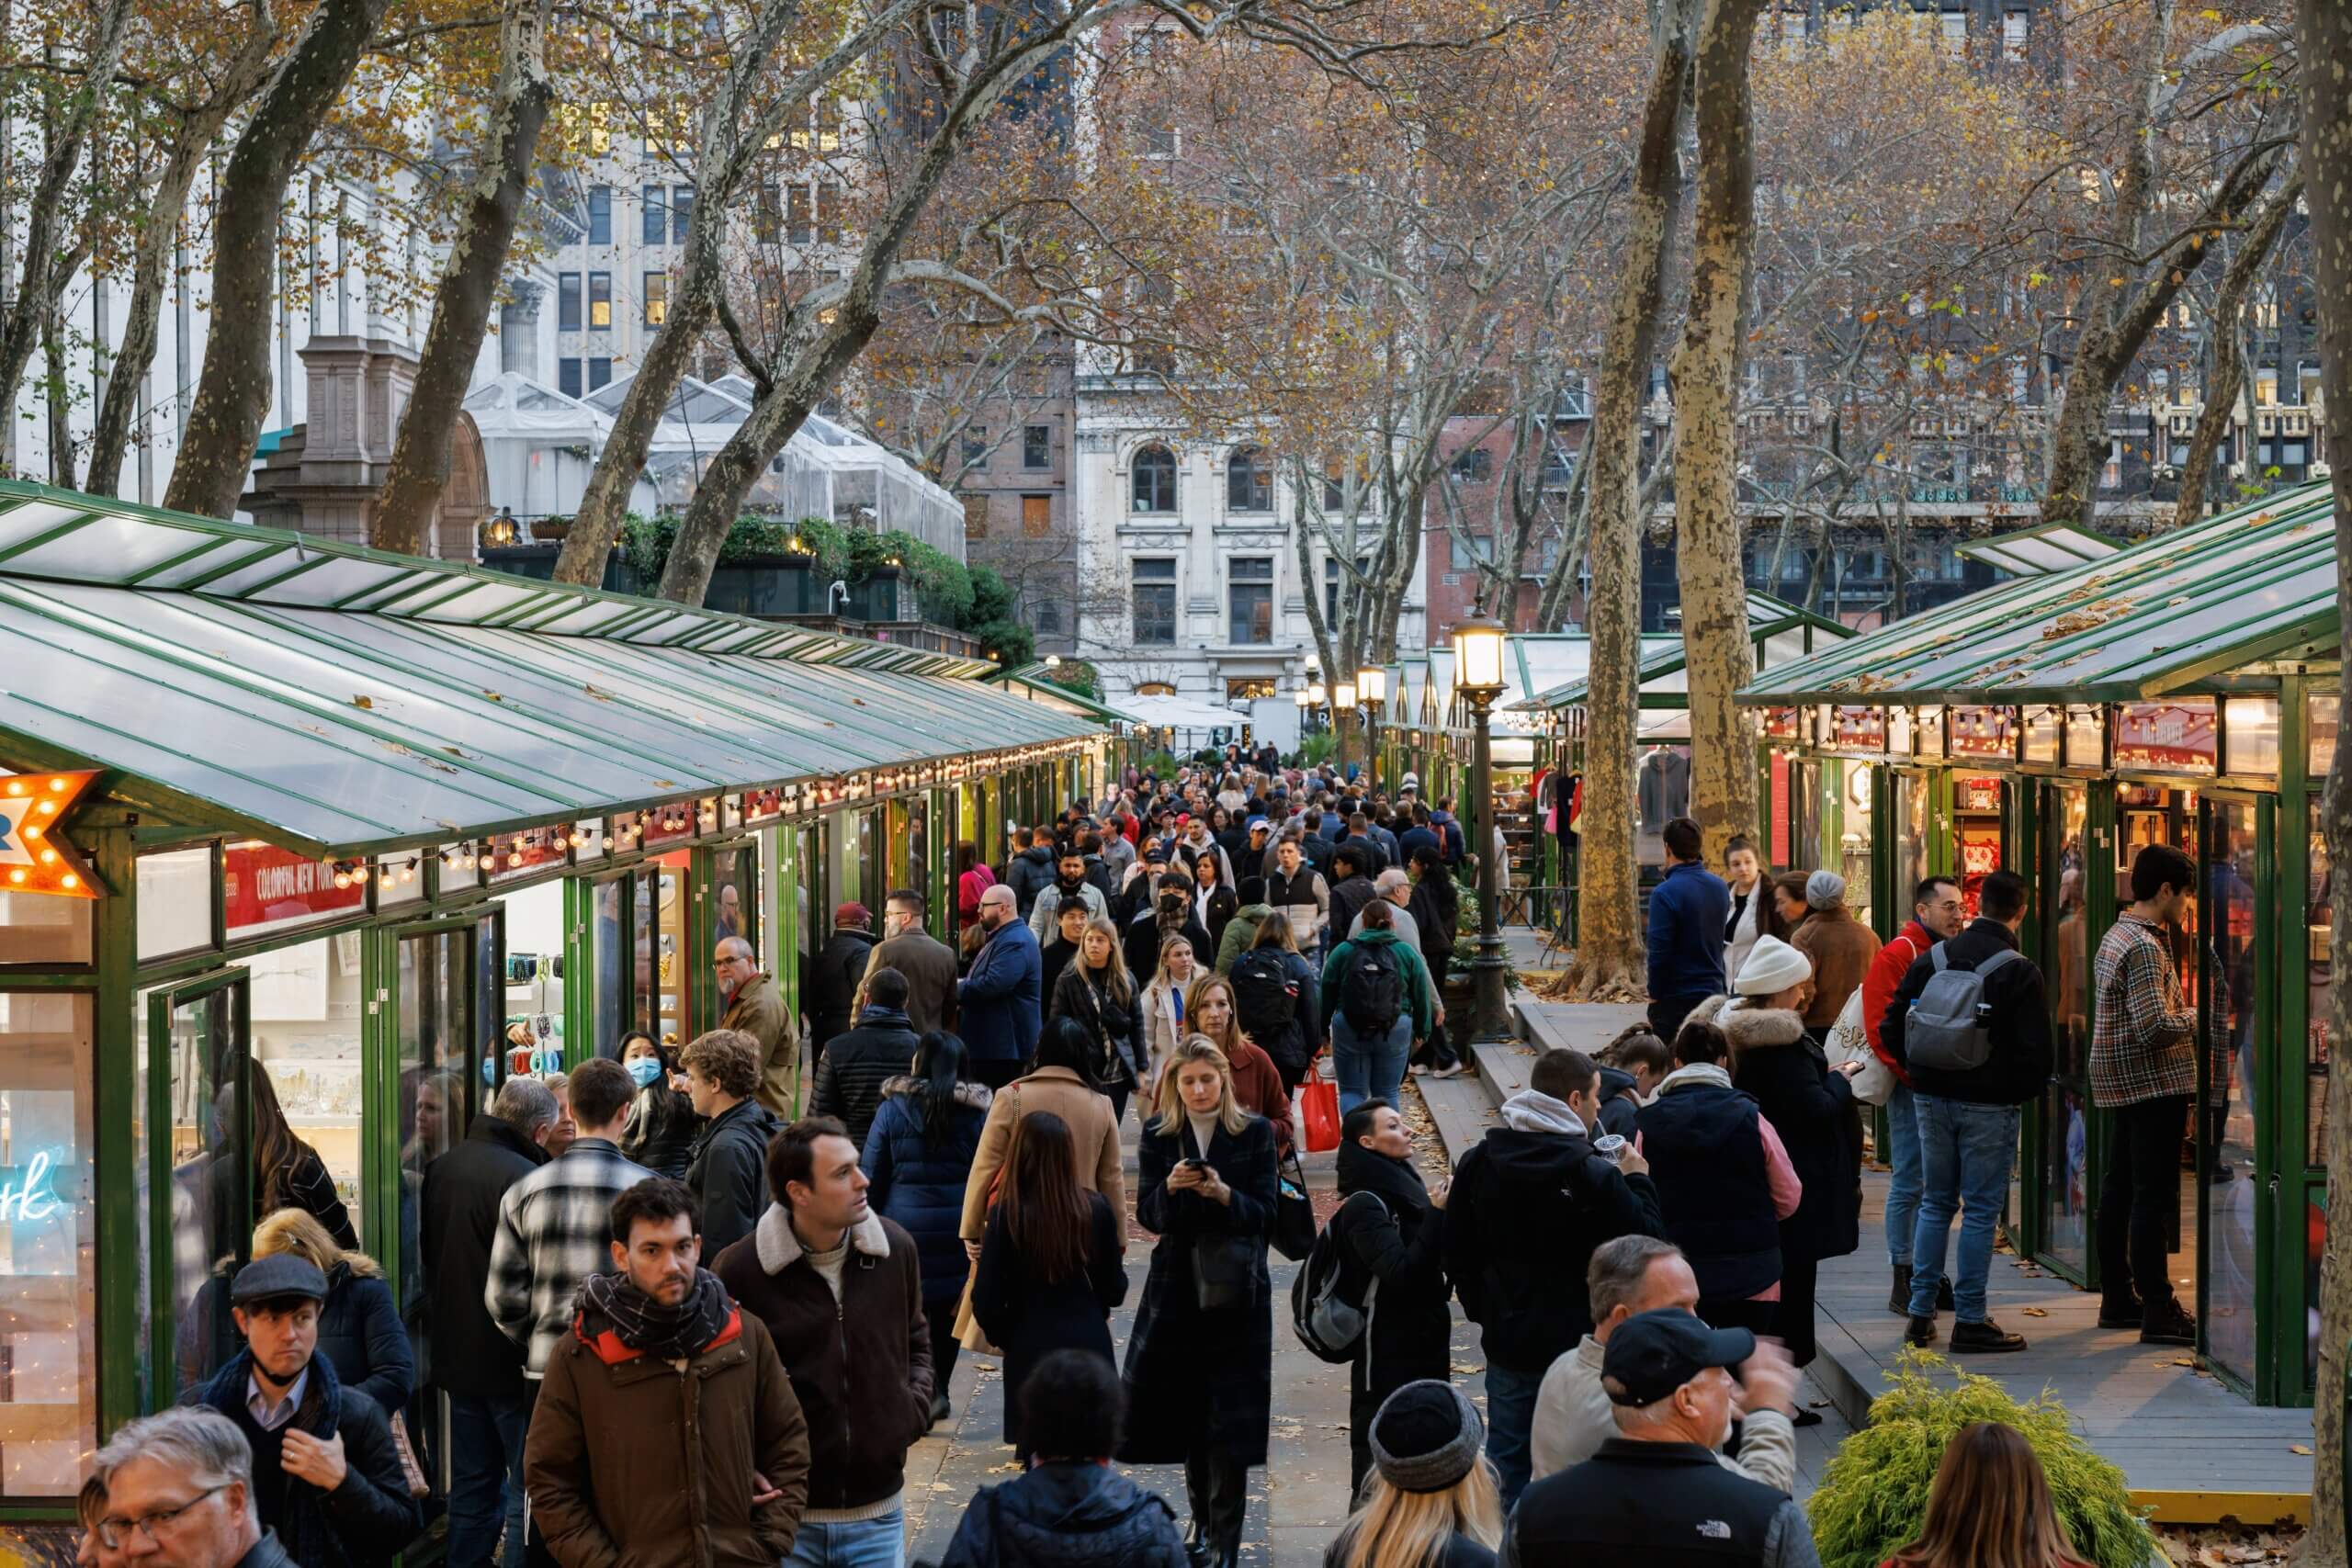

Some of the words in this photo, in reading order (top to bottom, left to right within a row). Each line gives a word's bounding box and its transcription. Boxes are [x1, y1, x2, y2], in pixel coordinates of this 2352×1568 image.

[256, 865, 295, 900] COLORFUL
[297, 863, 313, 895] NEW
[316, 860, 335, 892] YORK
